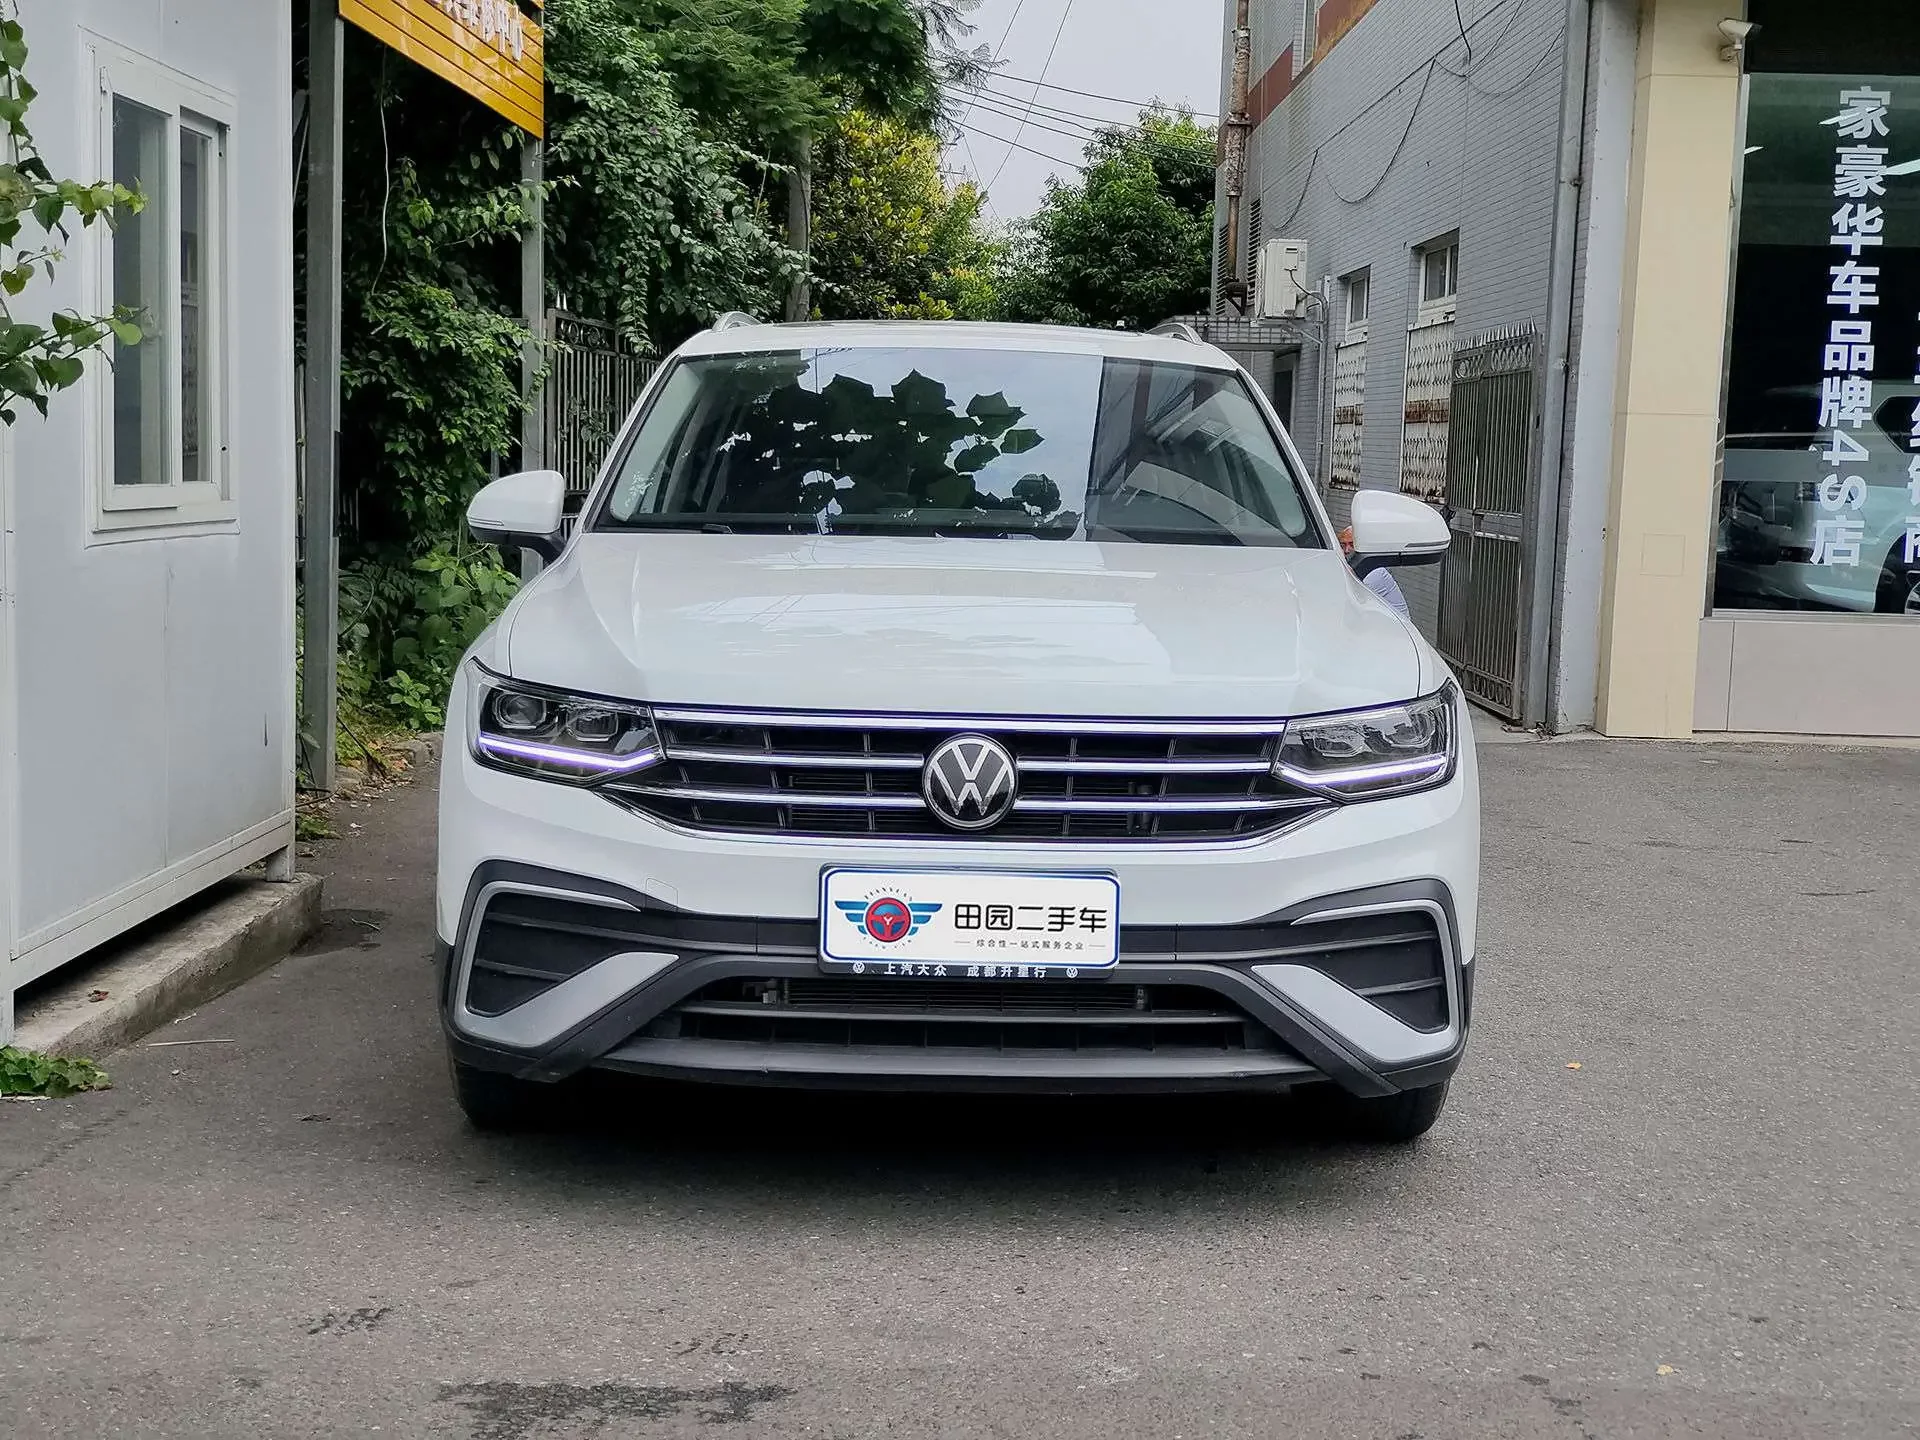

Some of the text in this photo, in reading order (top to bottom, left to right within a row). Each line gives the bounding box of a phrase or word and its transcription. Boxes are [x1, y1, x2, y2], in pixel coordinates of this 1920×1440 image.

[1809, 85, 1891, 568] 家豪华车品牌4S店
[954, 903, 1108, 934] 田园二手车
[976, 938, 1084, 950] 综合性一站式服务企业
[883, 962, 947, 977] 上汽大众
